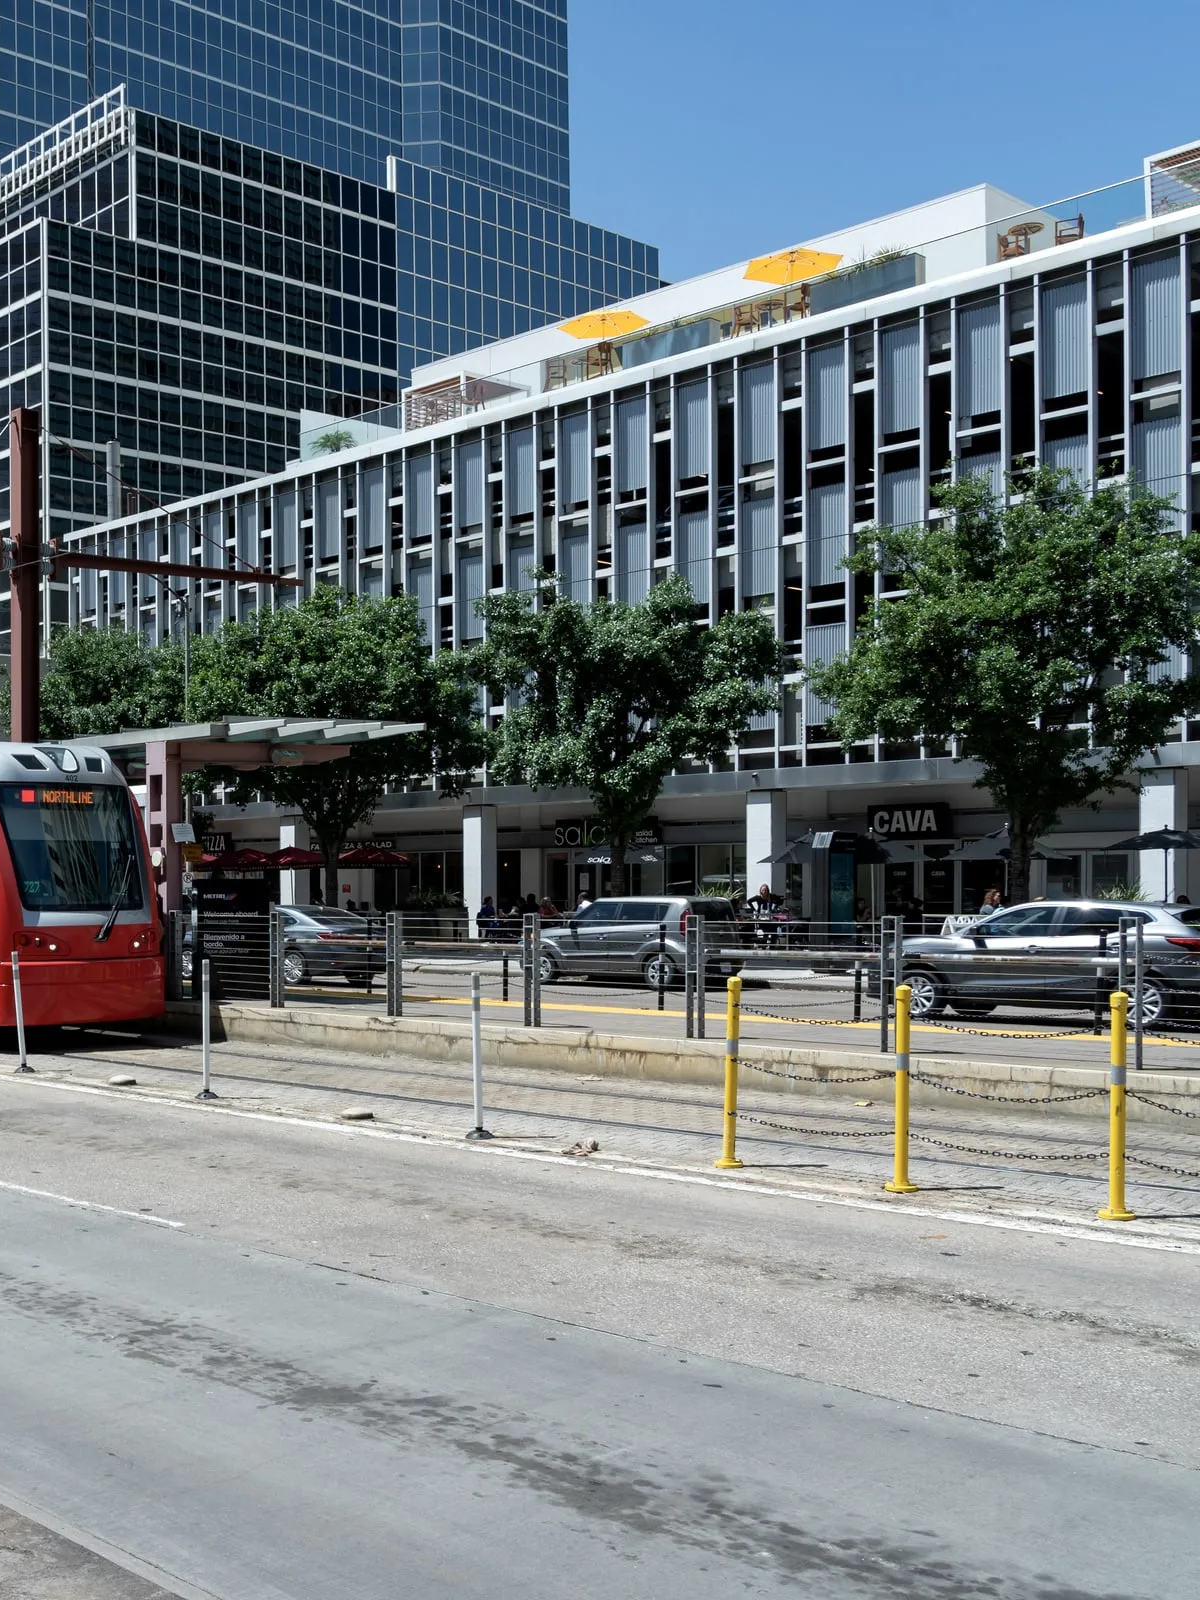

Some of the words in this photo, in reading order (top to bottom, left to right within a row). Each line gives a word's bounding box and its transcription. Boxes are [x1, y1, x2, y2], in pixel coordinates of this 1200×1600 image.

[64, 774, 79, 782] 402
[42, 790, 94, 804] NORTHLINE
[873, 809, 938, 834] CAVA
